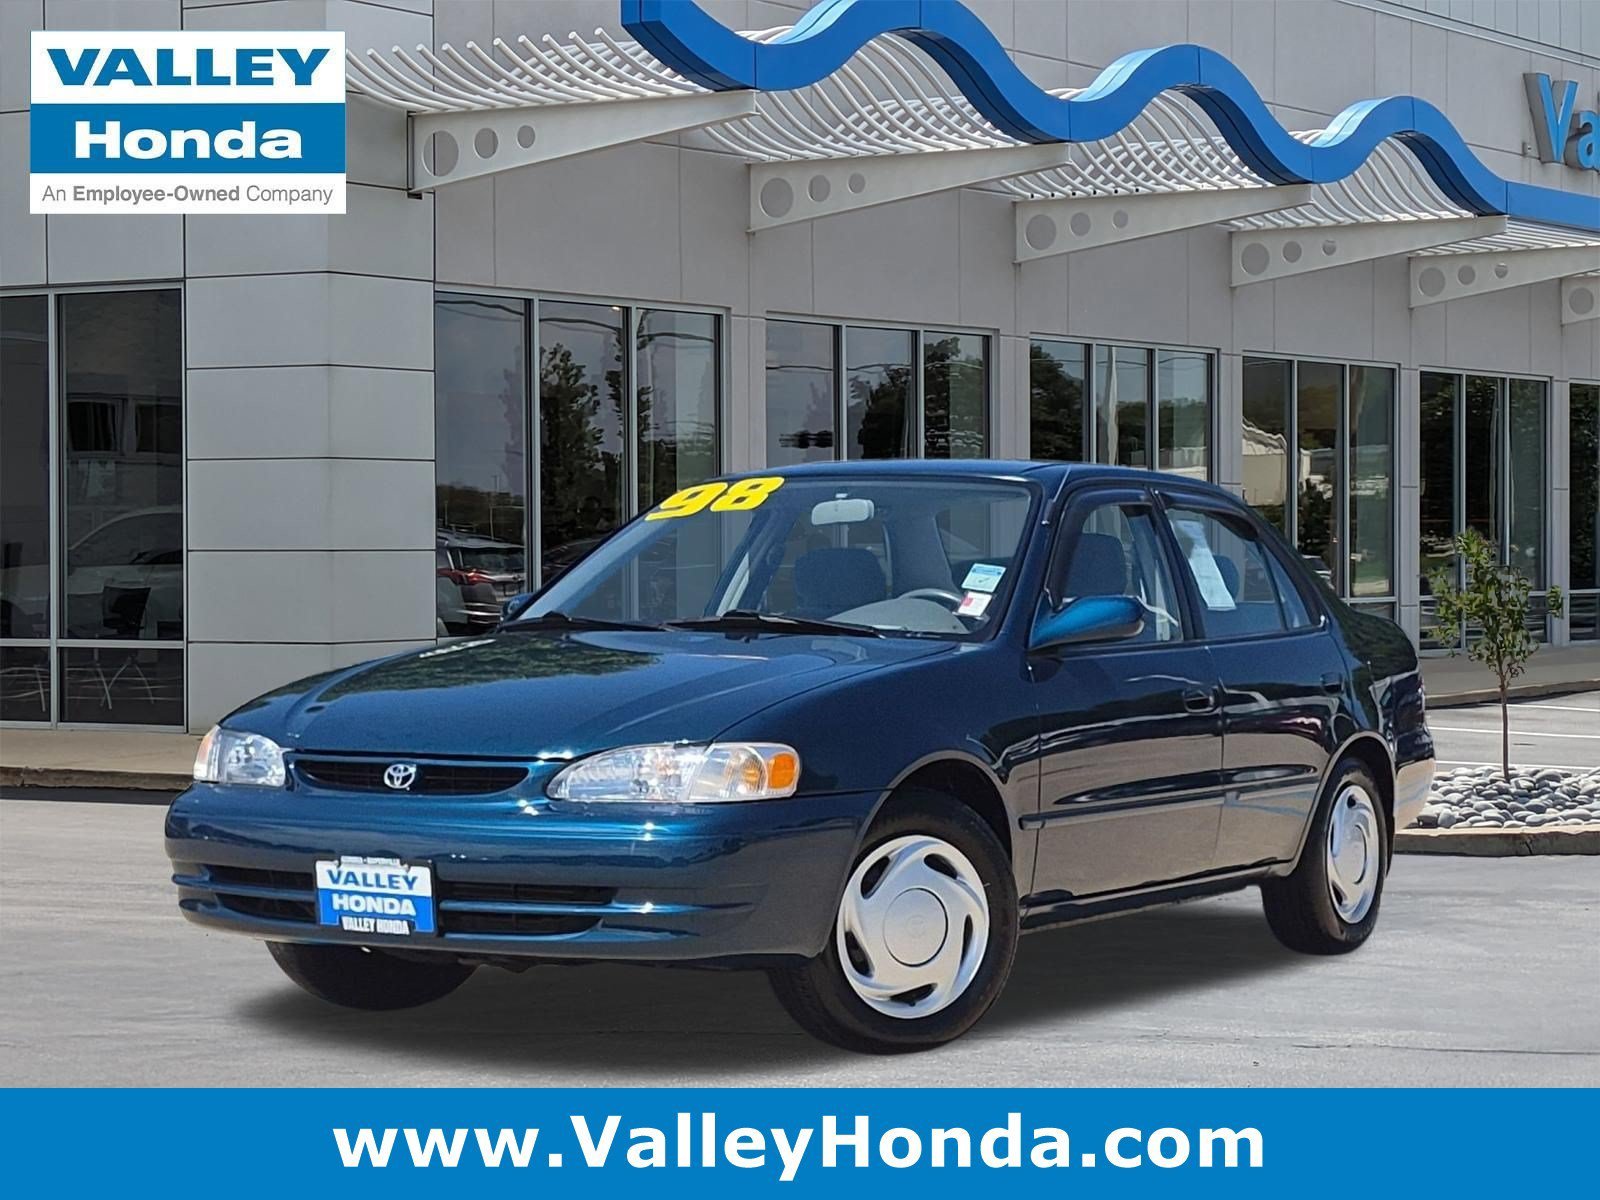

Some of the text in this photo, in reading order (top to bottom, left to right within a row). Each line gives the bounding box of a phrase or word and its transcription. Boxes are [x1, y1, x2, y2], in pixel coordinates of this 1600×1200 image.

[644, 476, 785, 521] 98
[326, 869, 418, 890] VALLEY
[331, 893, 417, 916] HONDA
[341, 916, 376, 932] VALLEY
